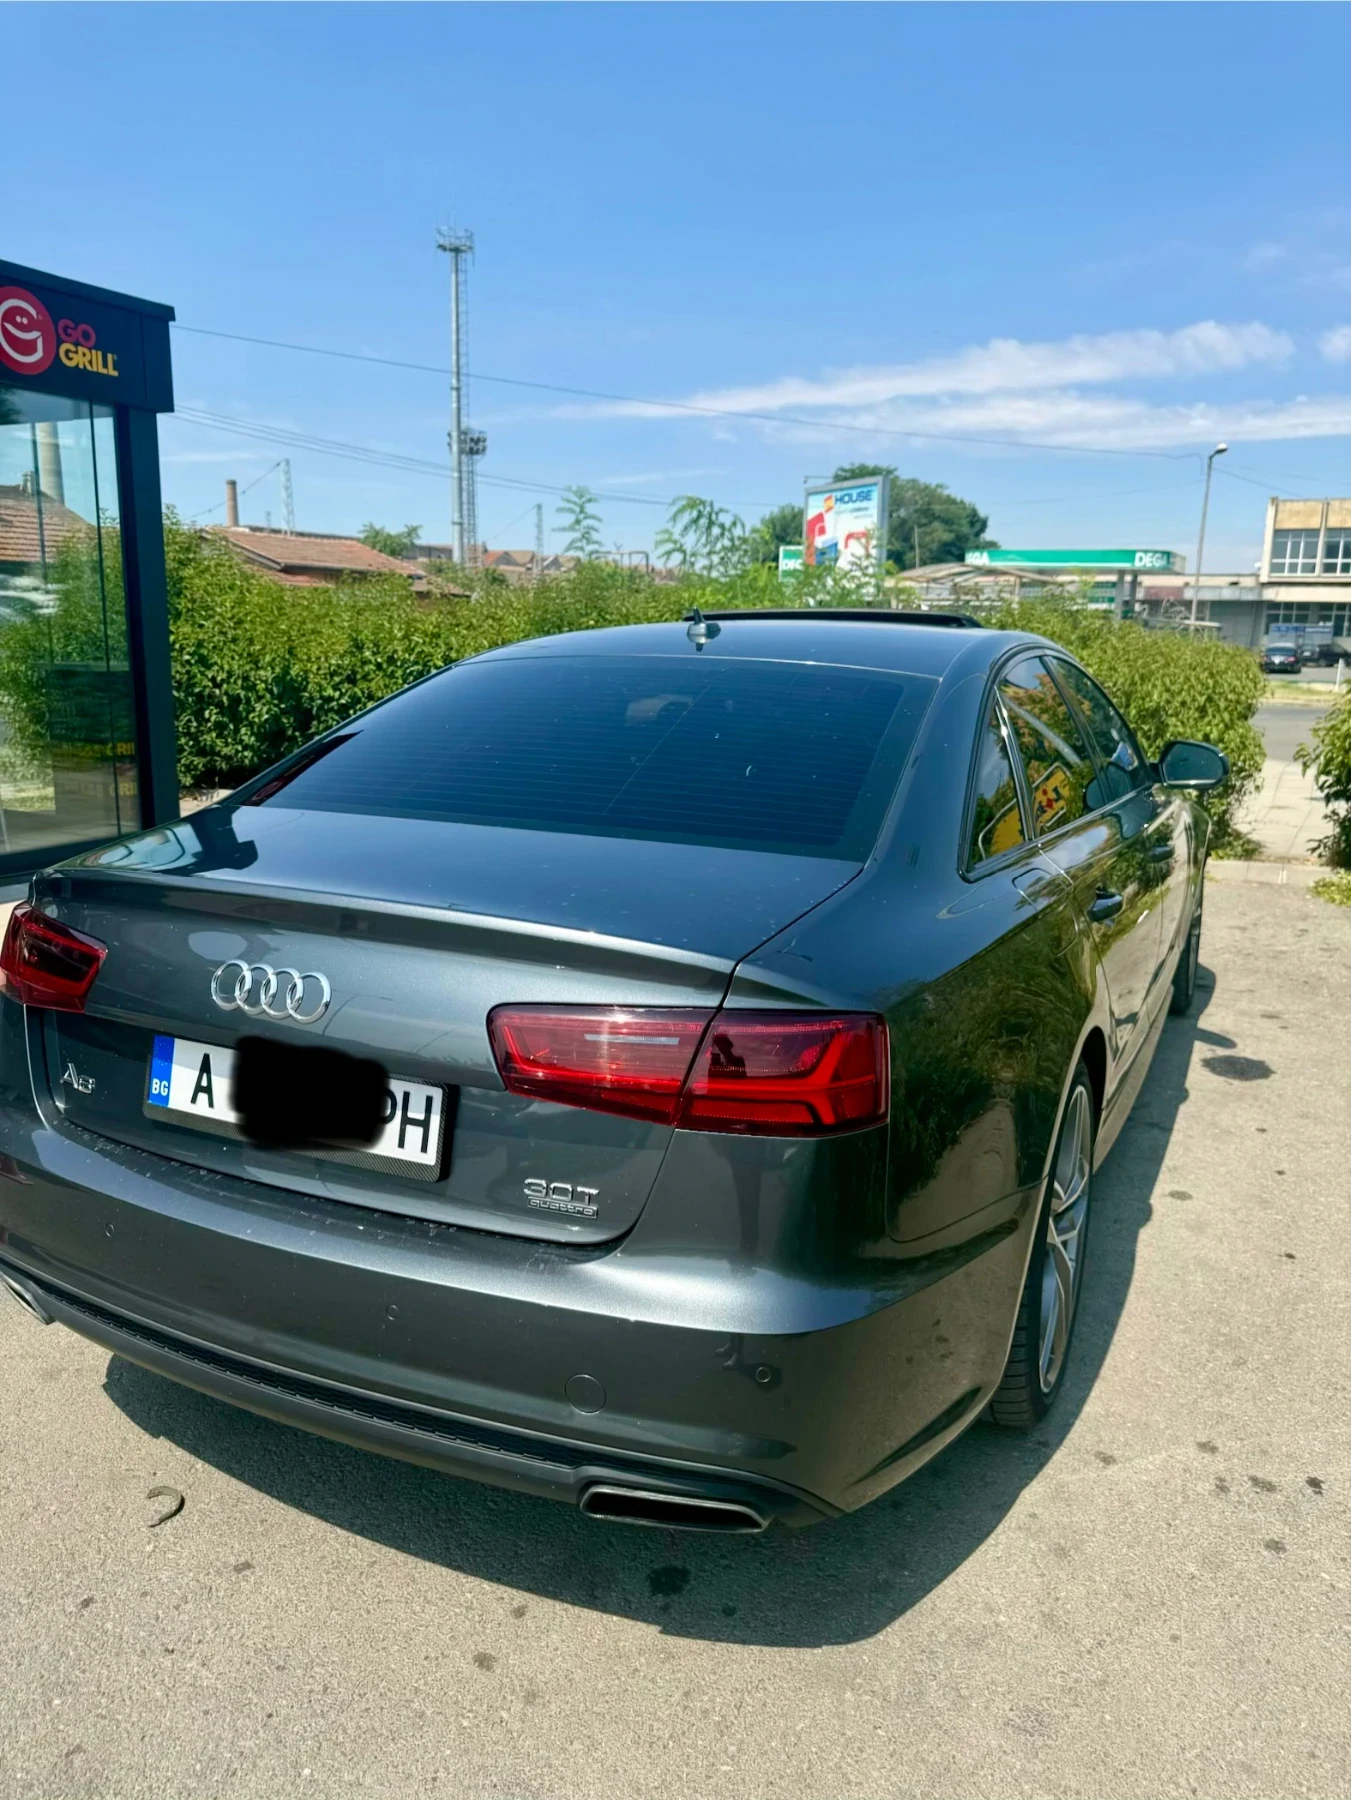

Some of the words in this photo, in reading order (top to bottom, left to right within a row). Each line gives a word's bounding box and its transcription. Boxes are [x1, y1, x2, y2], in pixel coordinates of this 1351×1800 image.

[58, 318, 96, 348] GO
[59, 342, 118, 376] GRILL
[834, 490, 873, 505] HOUSE
[965, 552, 991, 566] EGA
[1134, 552, 1169, 567] DEGA
[60, 1063, 95, 1094] A6
[151, 1078, 169, 1096] BG
[190, 1053, 214, 1109] A
[530, 1199, 594, 1216] quattro
